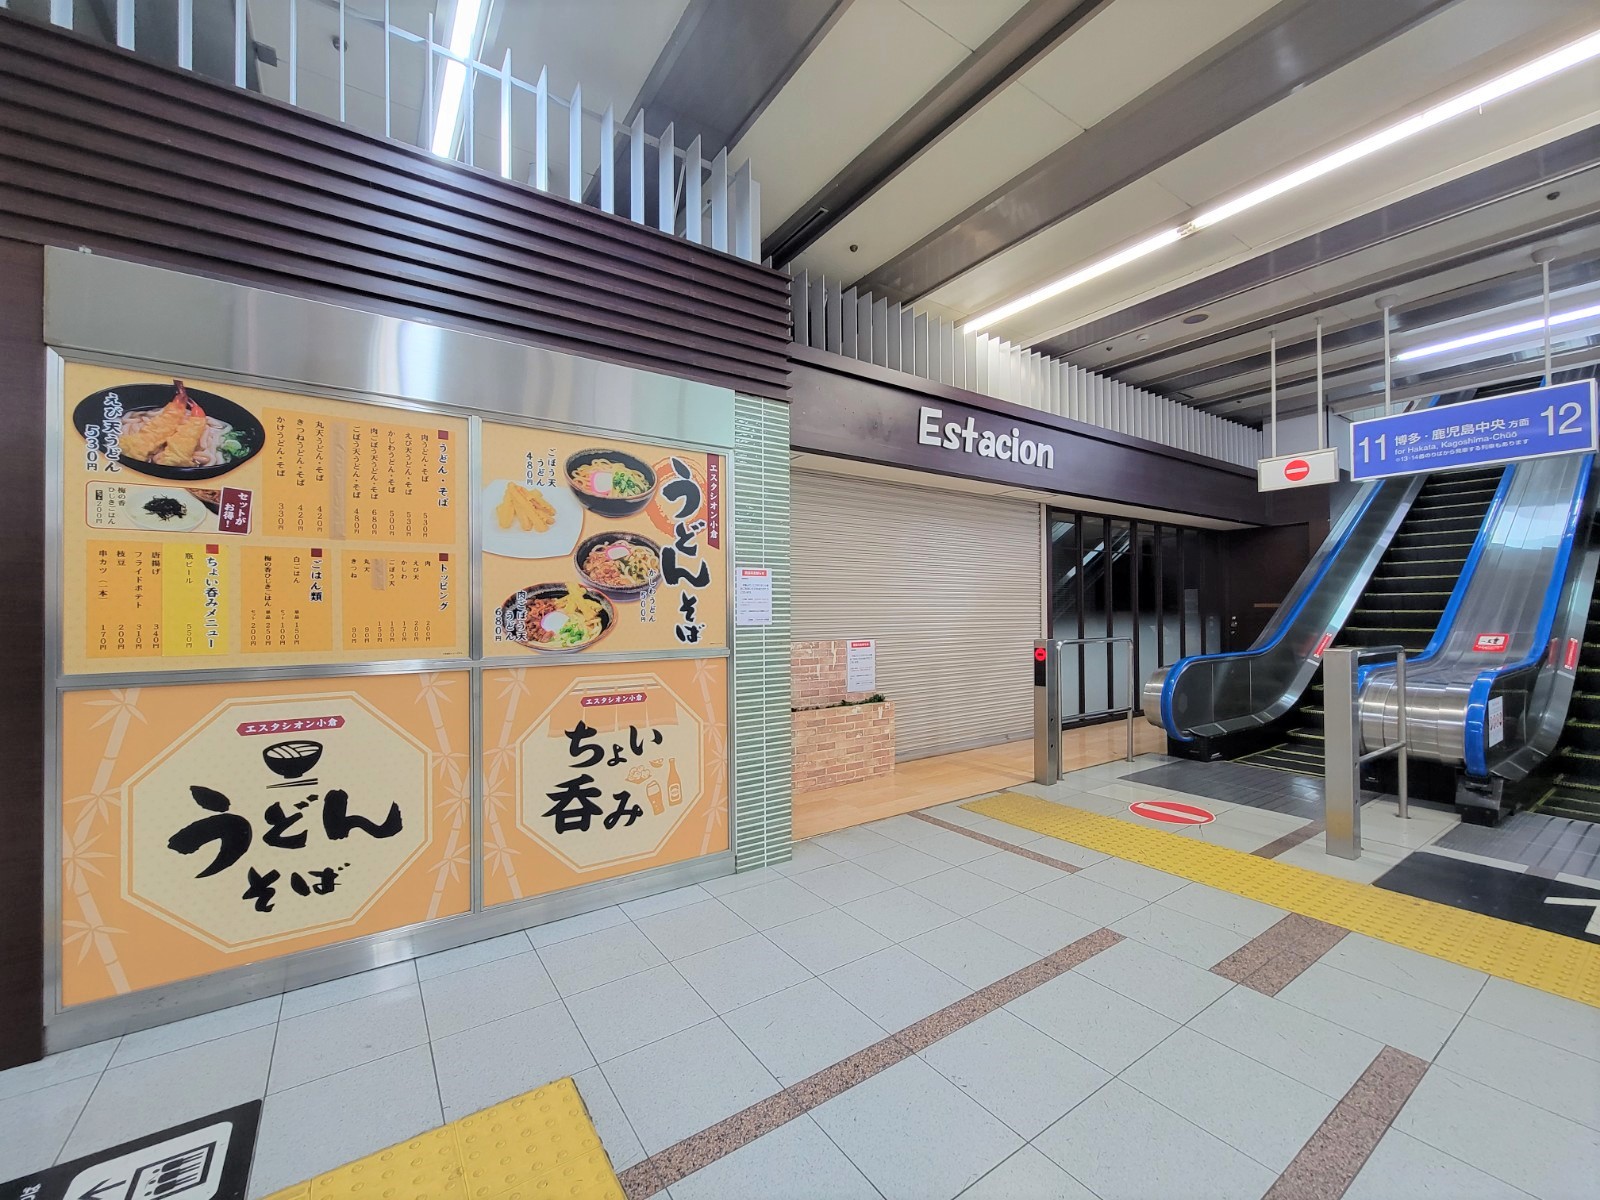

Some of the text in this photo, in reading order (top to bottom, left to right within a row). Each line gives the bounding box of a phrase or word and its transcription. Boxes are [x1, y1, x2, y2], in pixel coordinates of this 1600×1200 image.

[104, 393, 123, 472] えび天うどん
[919, 406, 1054, 469] Estacion
[1395, 418, 1529, 446] 博多・鹿児島中央 方面
[1541, 402, 1582, 436] 12
[85, 425, 100, 472] 530円
[548, 448, 556, 487] ごぼう天
[1359, 434, 1386, 463] 11
[1408, 443, 1438, 454] Hakata,
[438, 443, 448, 507] うどん・そば
[536, 459, 545, 486] うどん
[118, 487, 126, 506] 梅の香
[234, 492, 248, 526] セットが
[709, 464, 719, 539] エスタシオン小倉
[662, 456, 710, 588] うどん
[116, 550, 125, 566] 枝豆
[134, 552, 143, 608] フライドポテト
[310, 559, 323, 602] ごはん類
[205, 557, 218, 648] ちょい呑みメニュー
[439, 563, 449, 611] トッピング
[506, 611, 516, 641] うどん
[516, 590, 527, 641] 肉ごぼう天
[676, 591, 705, 643] そば
[585, 694, 643, 705] エスタシオン小倉
[246, 717, 339, 733] エスタシオン小倉
[565, 720, 663, 768] ちょい
[541, 774, 643, 834] 呑み
[168, 785, 403, 878] うどん
[242, 862, 351, 912] そば
